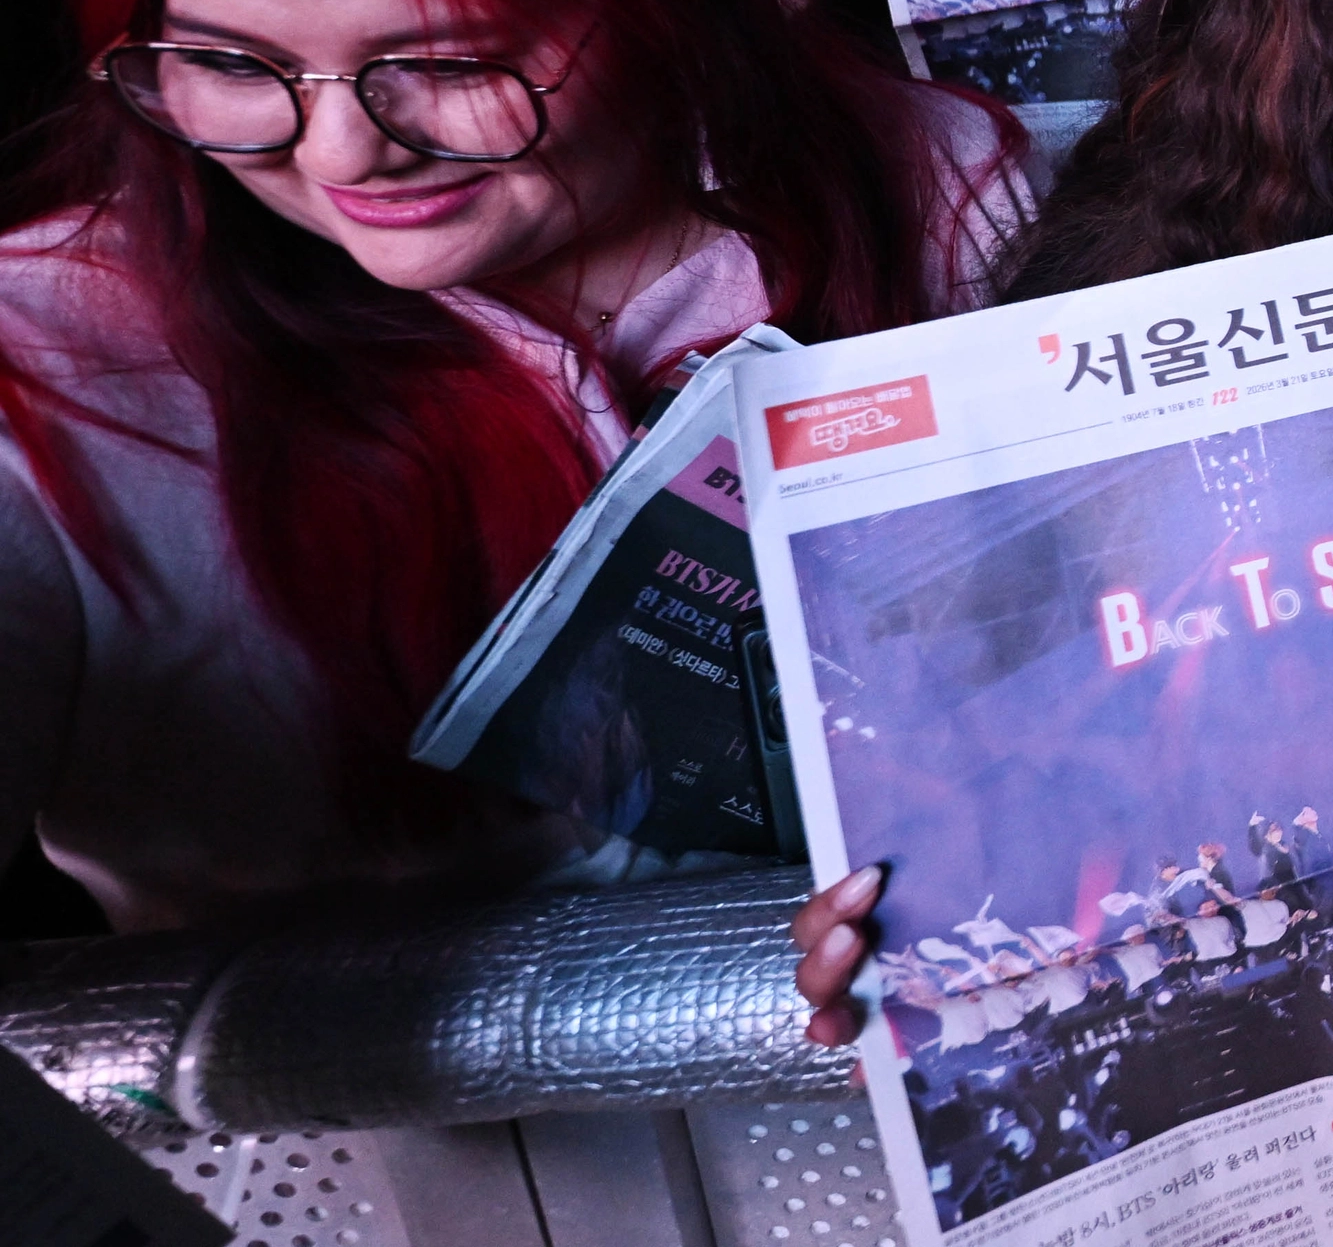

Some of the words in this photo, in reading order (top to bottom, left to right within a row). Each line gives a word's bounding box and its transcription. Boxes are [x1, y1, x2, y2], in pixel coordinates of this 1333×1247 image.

[1211, 386, 1239, 406] 122
[1245, 380, 1275, 395] 2026년
[1289, 372, 1309, 385] 21일
[1120, 409, 1150, 423] 1904년
[655, 547, 742, 605] BTS가
[1101, 592, 1230, 667] BACK
[1230, 557, 1301, 629] TO
[1116, 1189, 1157, 1223] BTS
[1224, 1144, 1260, 1171] 울려
[1264, 1124, 1316, 1155] 퍼진다
